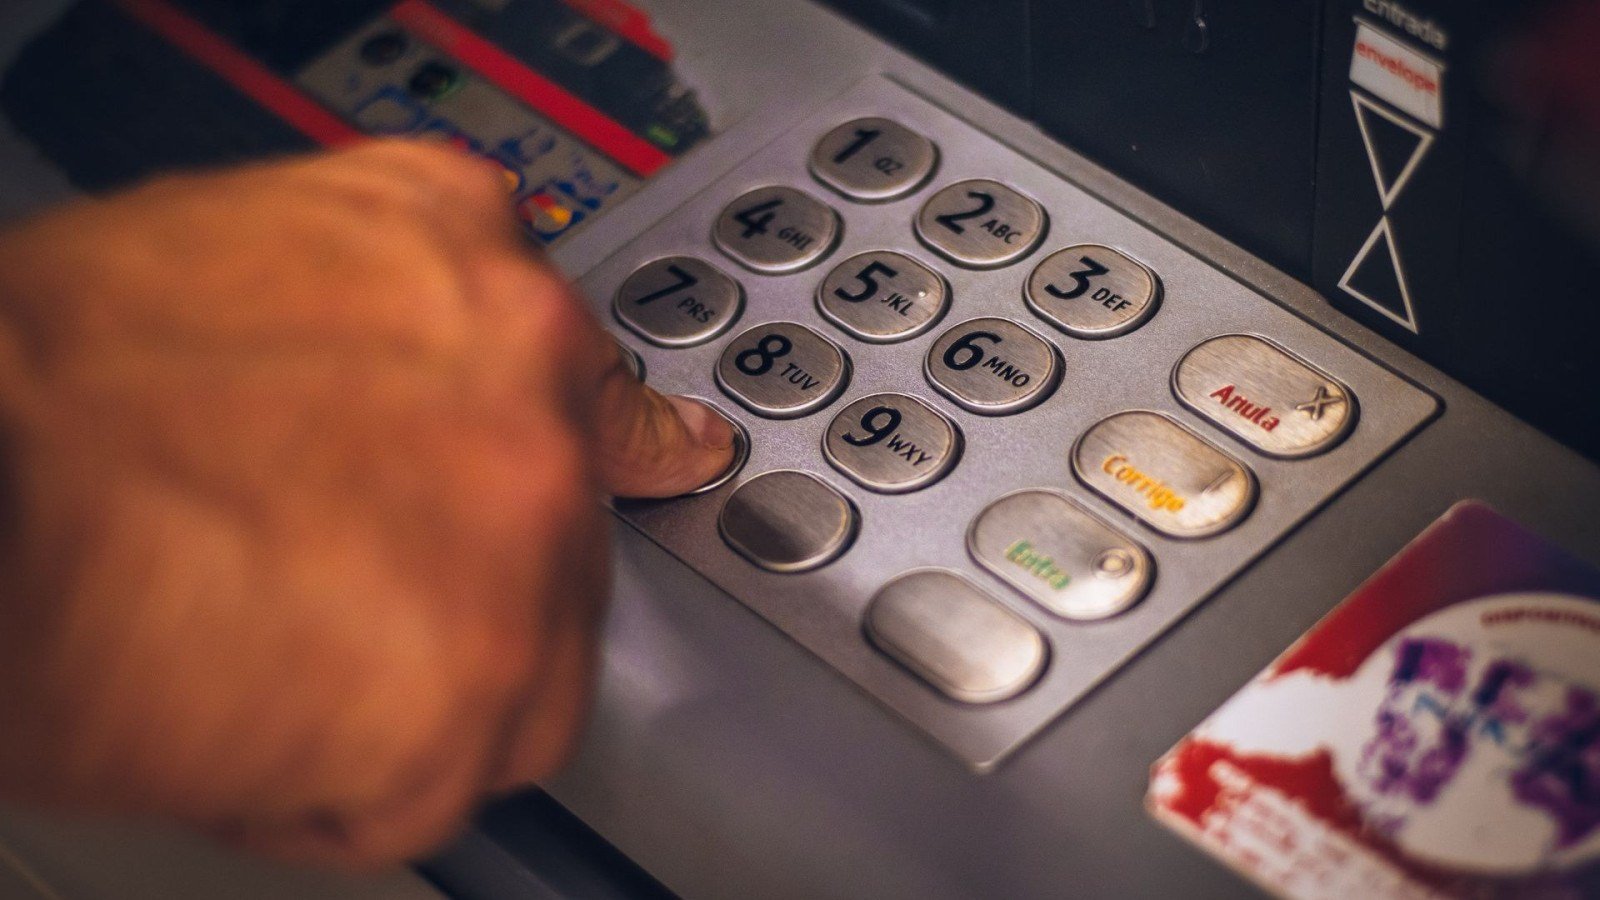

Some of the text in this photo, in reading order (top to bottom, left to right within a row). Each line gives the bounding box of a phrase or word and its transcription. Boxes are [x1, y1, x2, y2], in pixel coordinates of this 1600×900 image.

[1356, 42, 1437, 93] envelope
[833, 129, 880, 164] 1
[733, 199, 785, 239] 4
[935, 191, 1022, 244] 2 ABC
[634, 265, 715, 323] 7 PRS
[834, 261, 915, 317] 5 JKL
[1044, 256, 1132, 312] 3 DEF
[735, 334, 820, 391] 8 TUV
[943, 331, 1031, 388] 6 MNO
[842, 406, 932, 467] 9 WXY
[1210, 384, 1280, 433] Anula
[1102, 455, 1186, 513] Corrige
[1004, 539, 1072, 590] Entra
